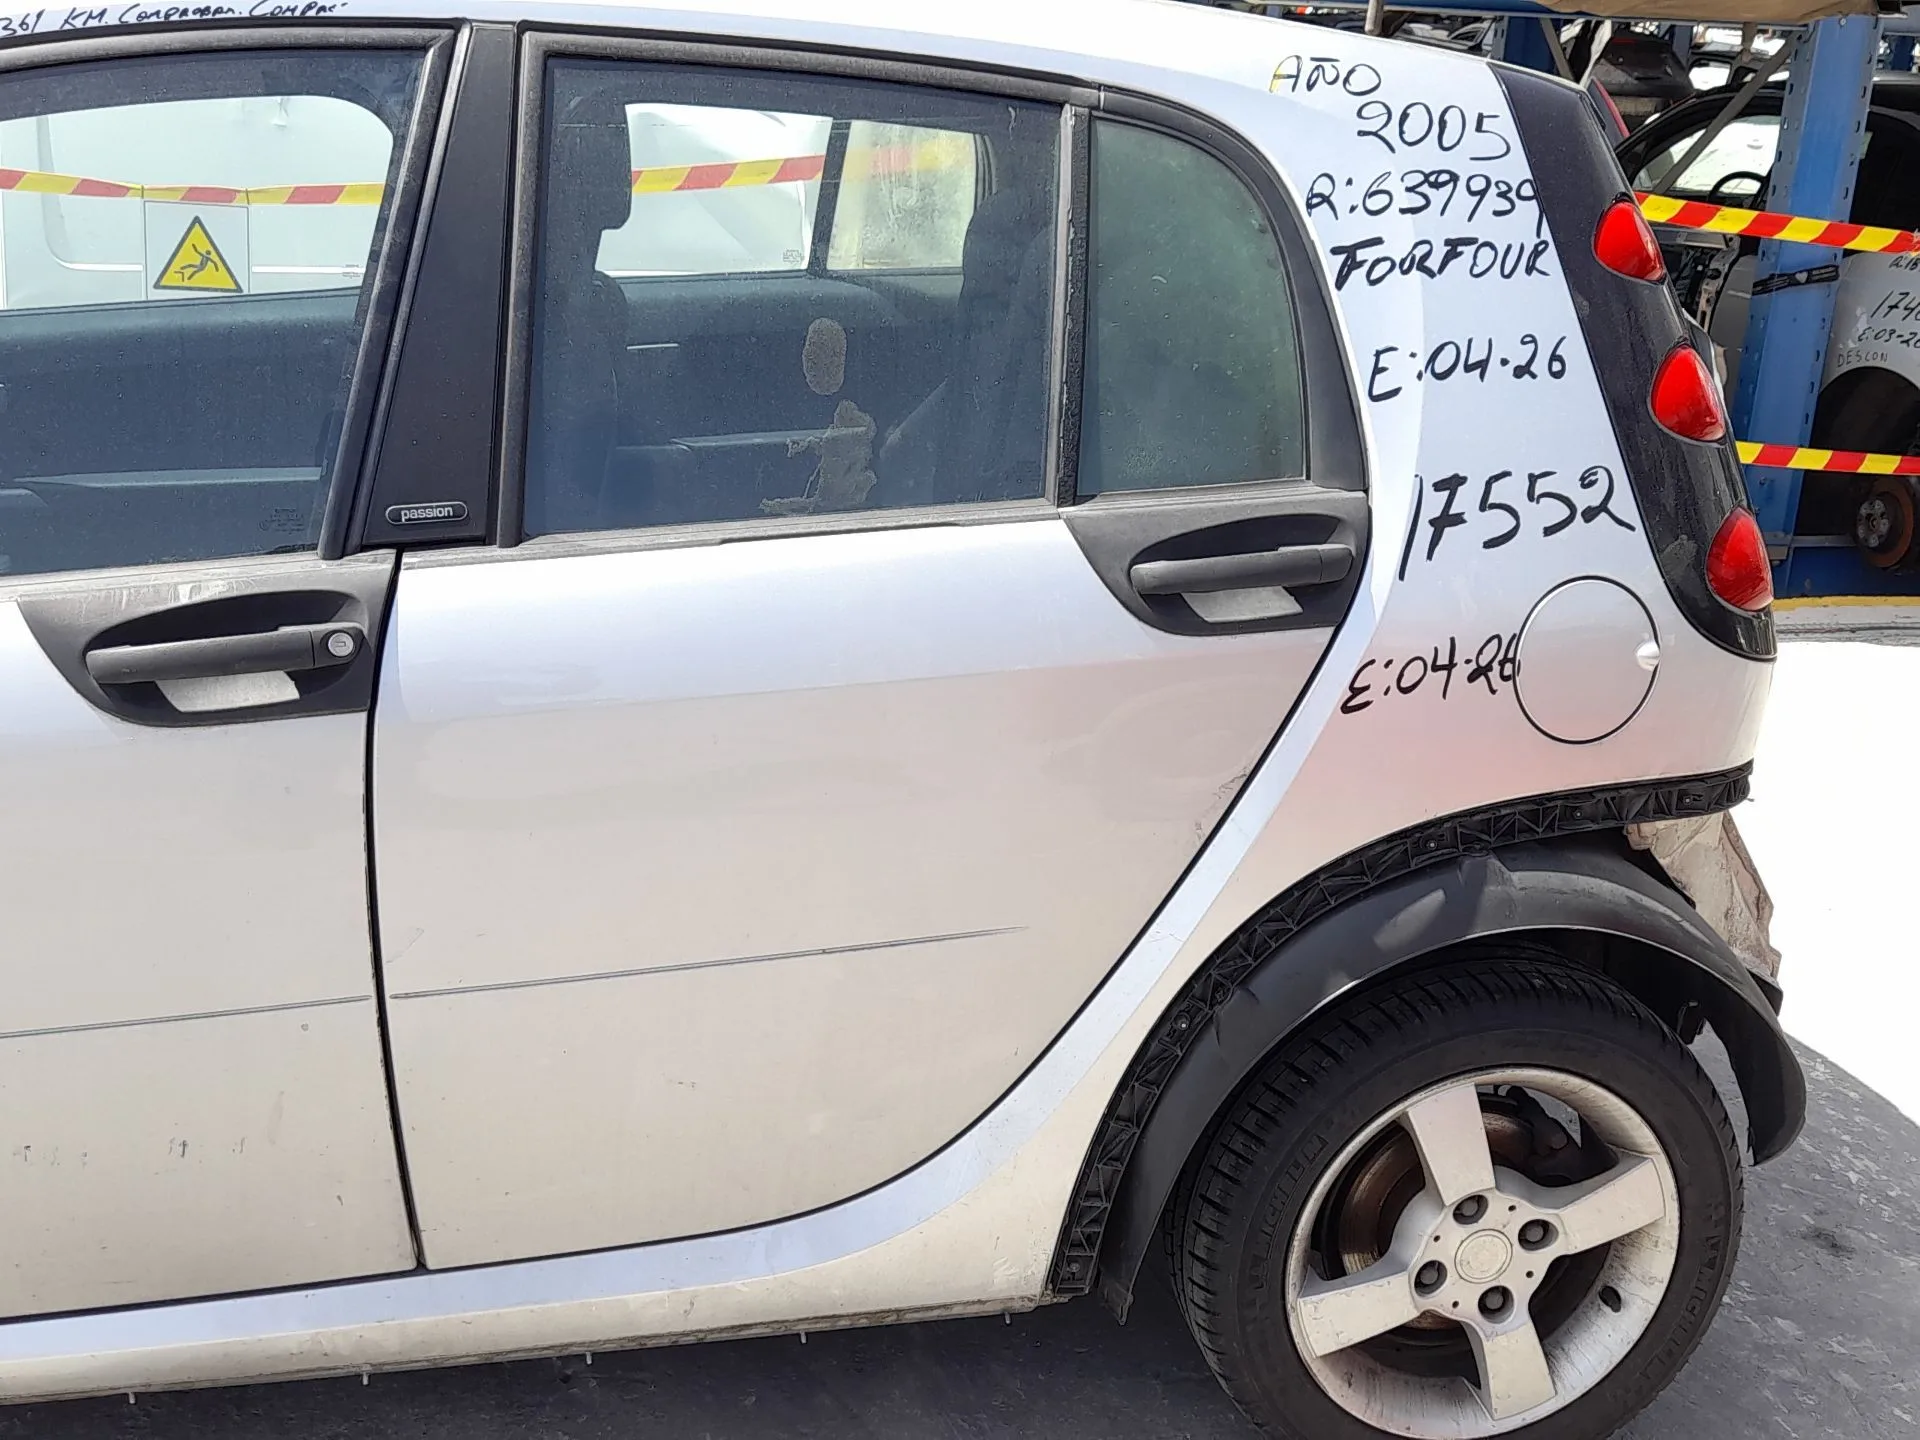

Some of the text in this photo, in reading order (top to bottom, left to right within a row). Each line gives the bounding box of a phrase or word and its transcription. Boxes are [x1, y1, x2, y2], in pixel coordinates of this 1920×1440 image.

[1269, 55, 1382, 97] AÑO
[1356, 100, 1511, 161] 2005
[1331, 236, 1551, 291] FORFOUR
[400, 505, 454, 523] passion
[1399, 465, 1637, 582] 17552
